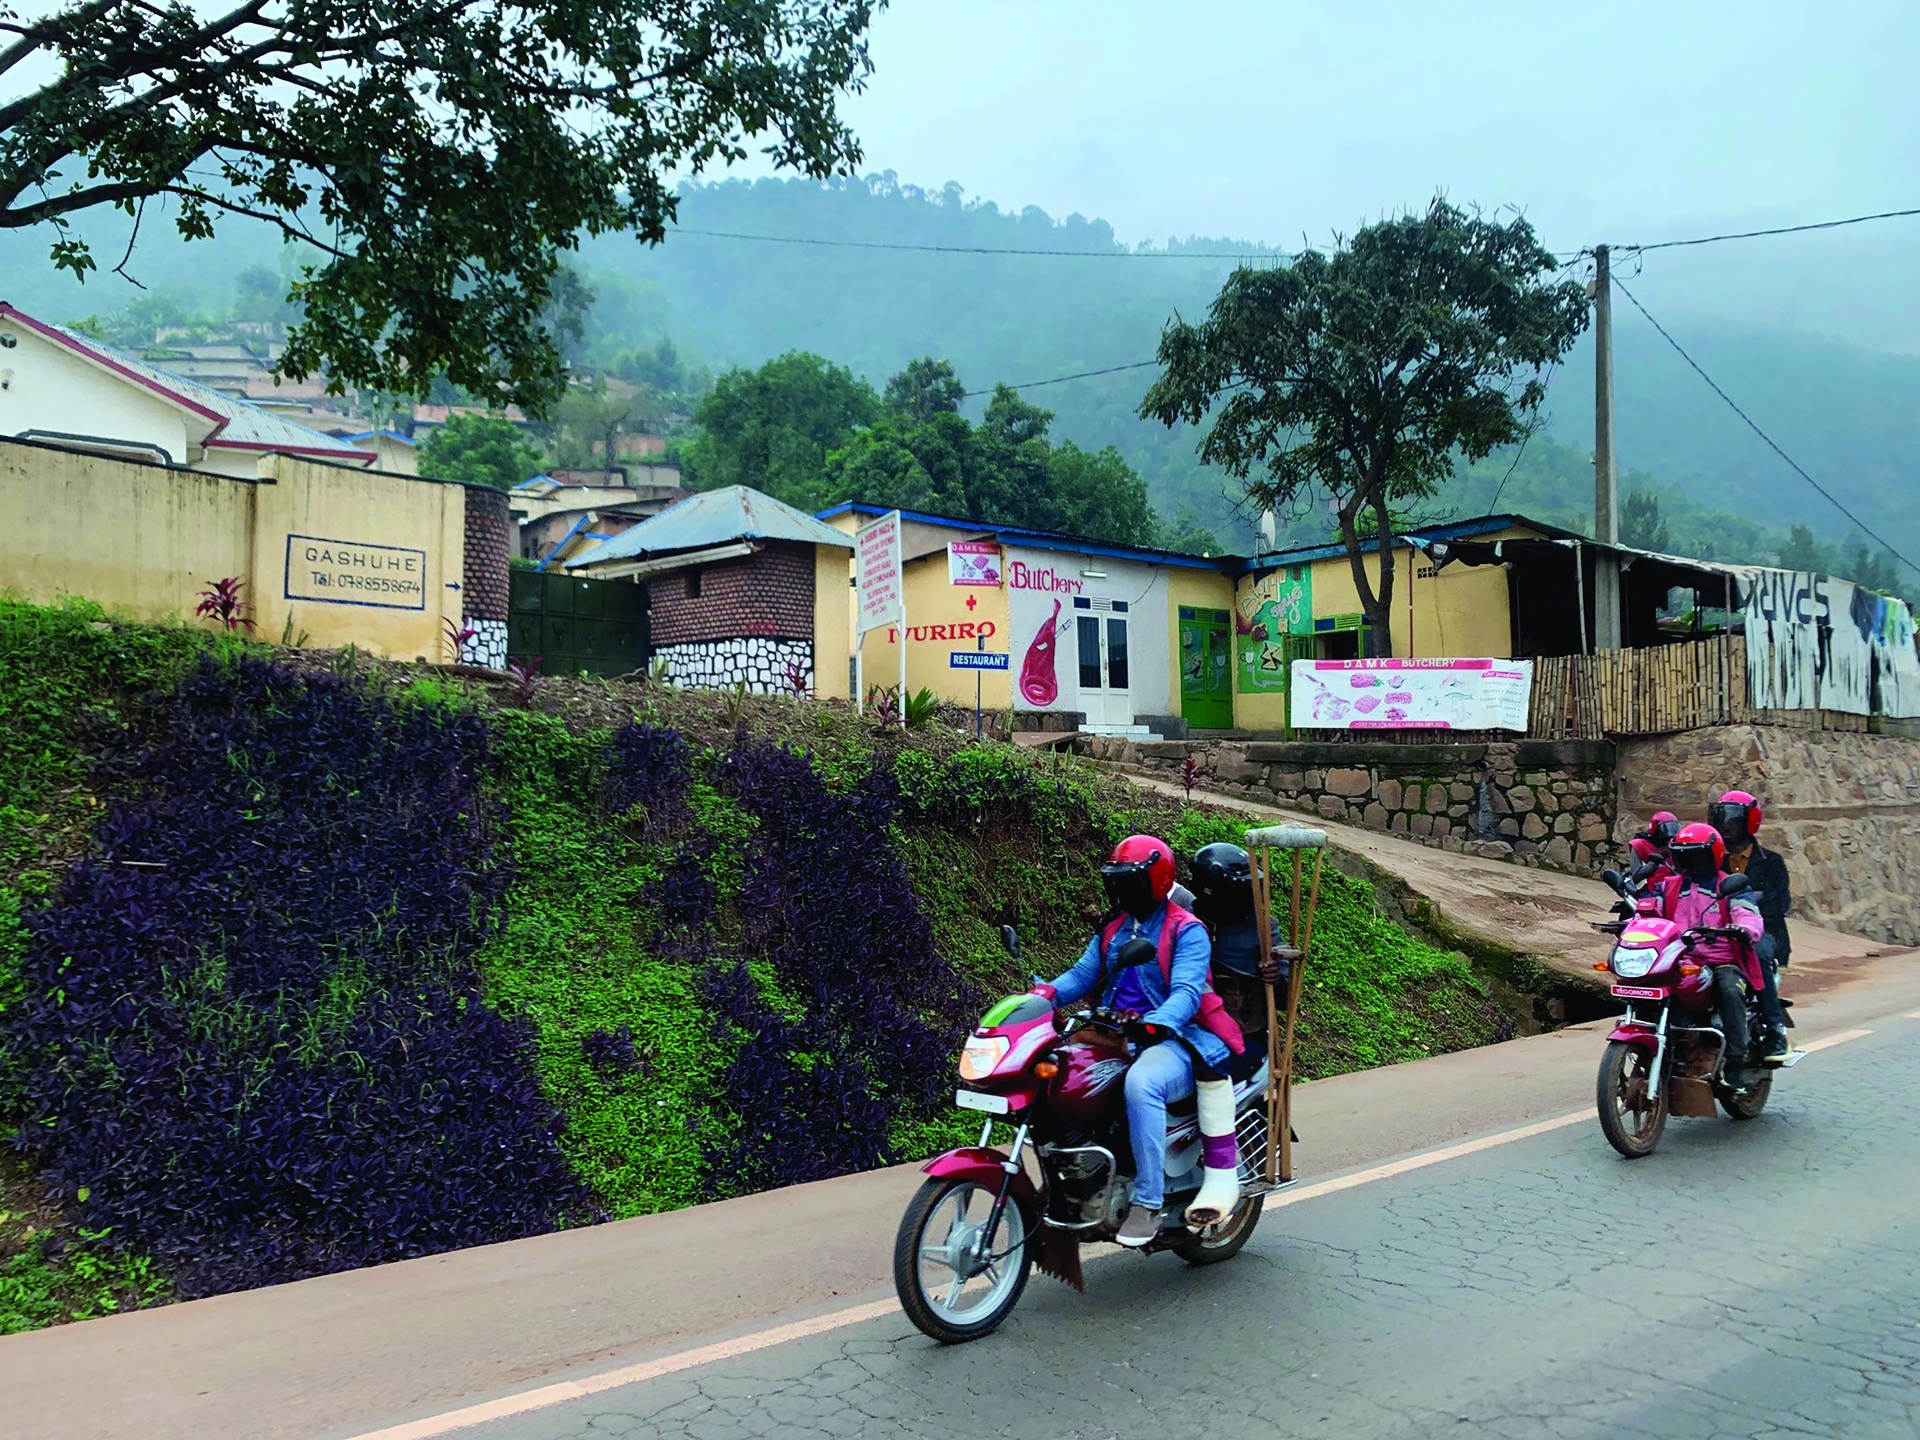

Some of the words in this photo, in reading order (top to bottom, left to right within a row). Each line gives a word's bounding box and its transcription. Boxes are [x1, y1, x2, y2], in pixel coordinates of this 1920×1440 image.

[305, 547, 417, 572] GASHUHE
[1009, 561, 1084, 594] Butchery
[953, 654, 1006, 667] RESTAURANT
[1401, 658, 1456, 668] BUTCHERY
